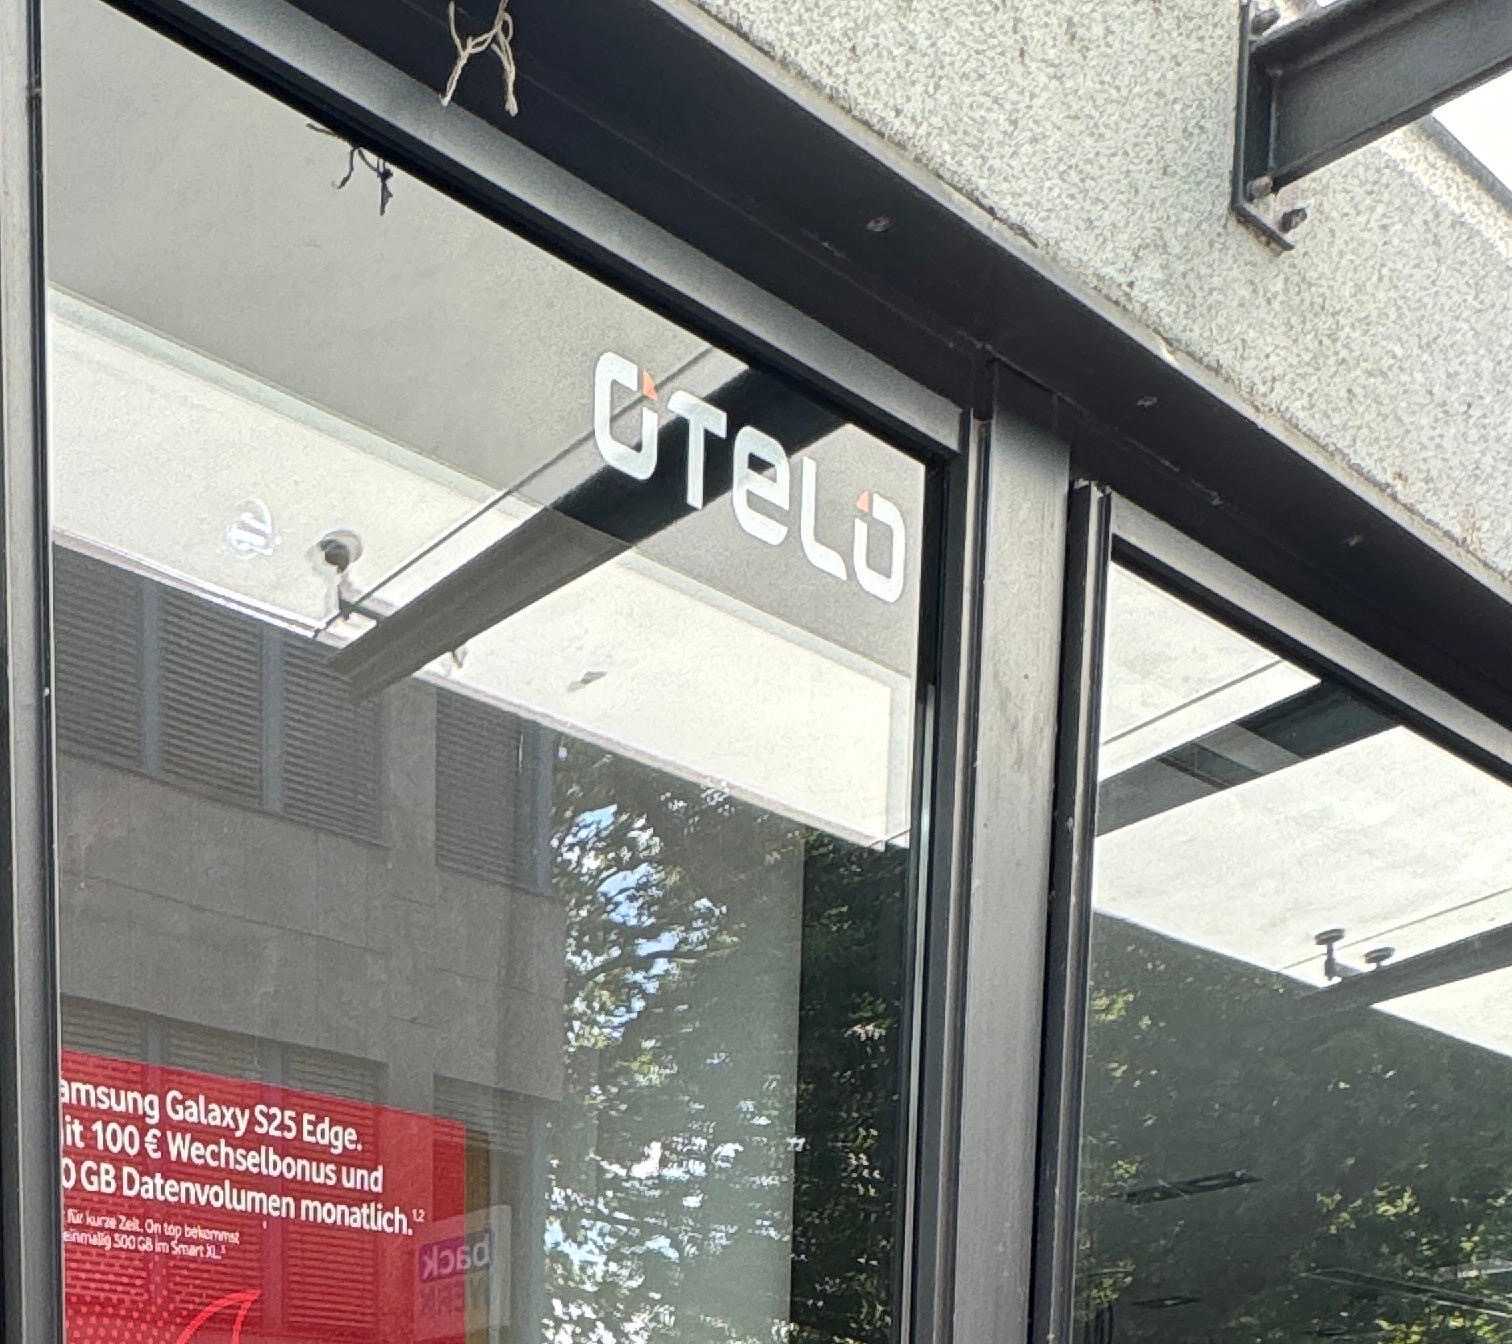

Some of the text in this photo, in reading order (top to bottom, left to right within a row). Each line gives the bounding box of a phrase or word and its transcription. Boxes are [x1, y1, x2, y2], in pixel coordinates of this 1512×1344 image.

[165, 1089, 250, 1138] Galaxy
[254, 1103, 298, 1139] S25
[301, 1112, 363, 1156] Edge.
[90, 1119, 141, 1157] 100
[144, 1128, 162, 1160] €
[167, 1130, 337, 1186] Wechselbonus
[341, 1164, 384, 1194] und
[80, 1160, 117, 1196] GB
[121, 1166, 296, 1220] Datenvolumen
[86, 1211, 118, 1231] kurze
[144, 1218, 162, 1235] On
[163, 1222, 182, 1240] top
[184, 1224, 240, 1246] bekommst
[113, 1232, 136, 1250] 500
[137, 1236, 154, 1252] GB
[154, 1237, 170, 1254] im
[170, 1240, 205, 1258] Smart
